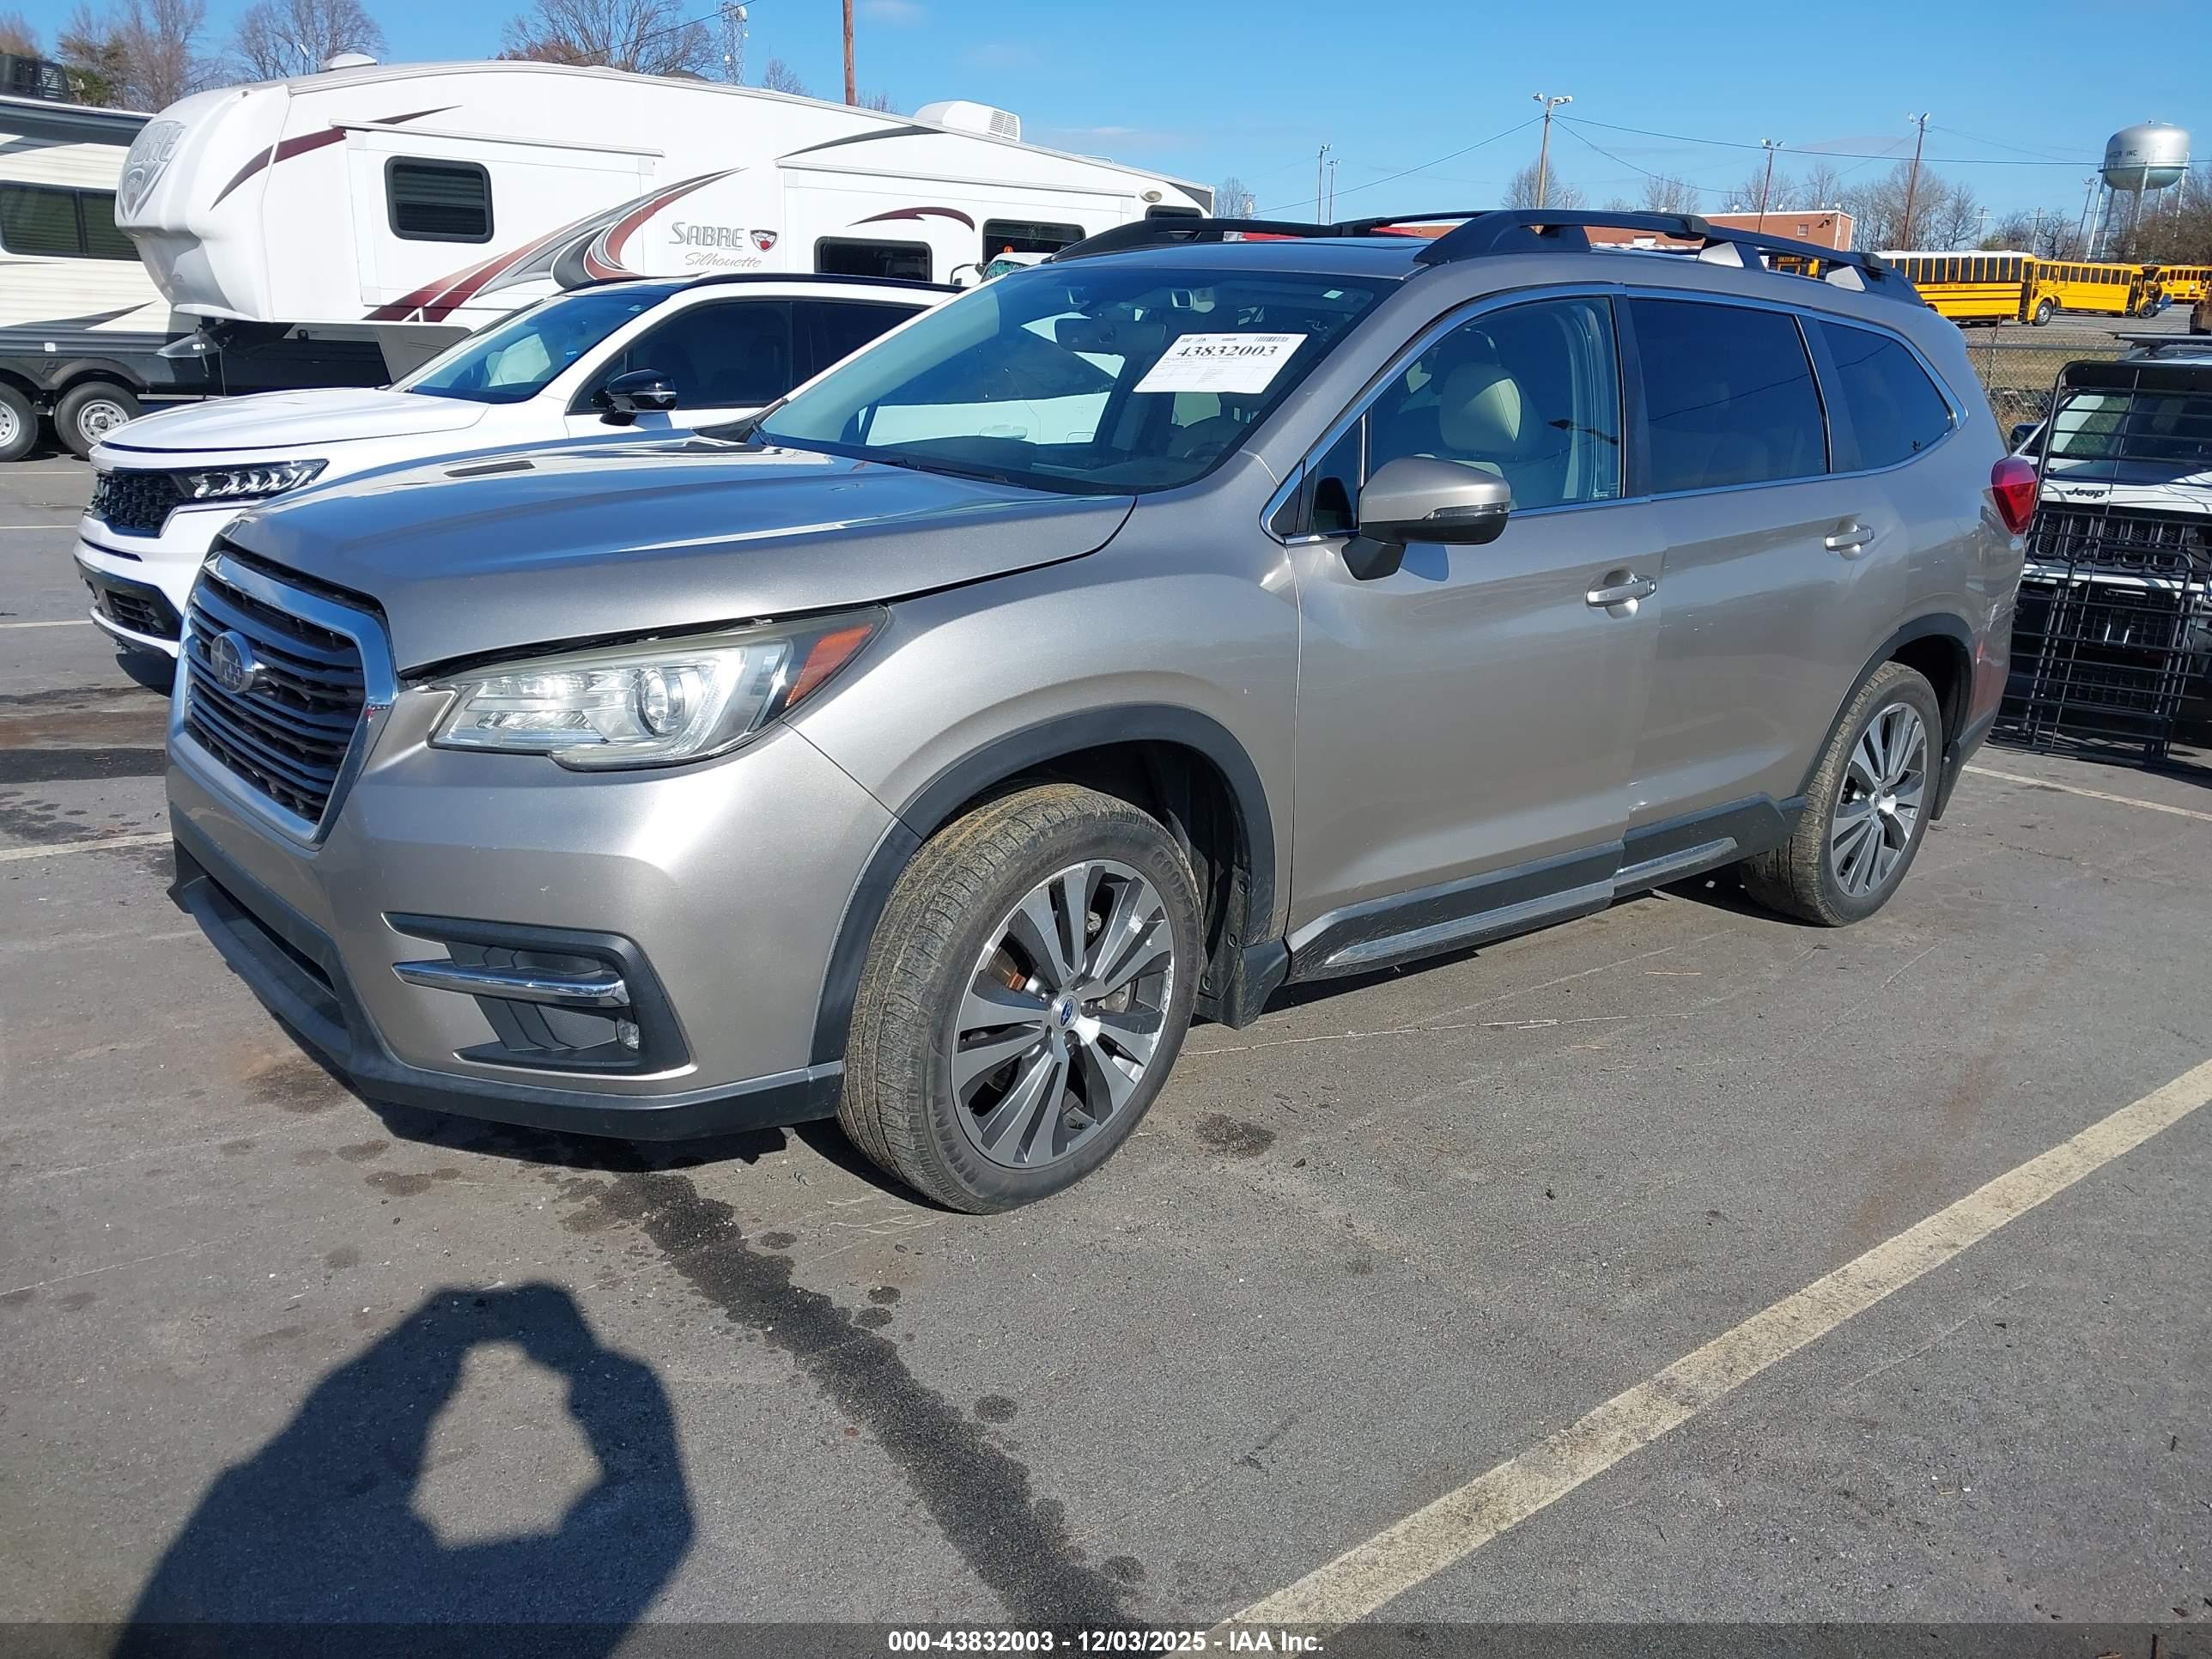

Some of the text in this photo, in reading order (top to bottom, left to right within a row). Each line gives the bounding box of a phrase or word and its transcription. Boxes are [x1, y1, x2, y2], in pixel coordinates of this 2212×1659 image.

[668, 221, 744, 248] SABRE
[684, 252, 763, 268] Silhouette
[1176, 345, 1278, 357] 43832003
[2066, 487, 2106, 500] Jeep
